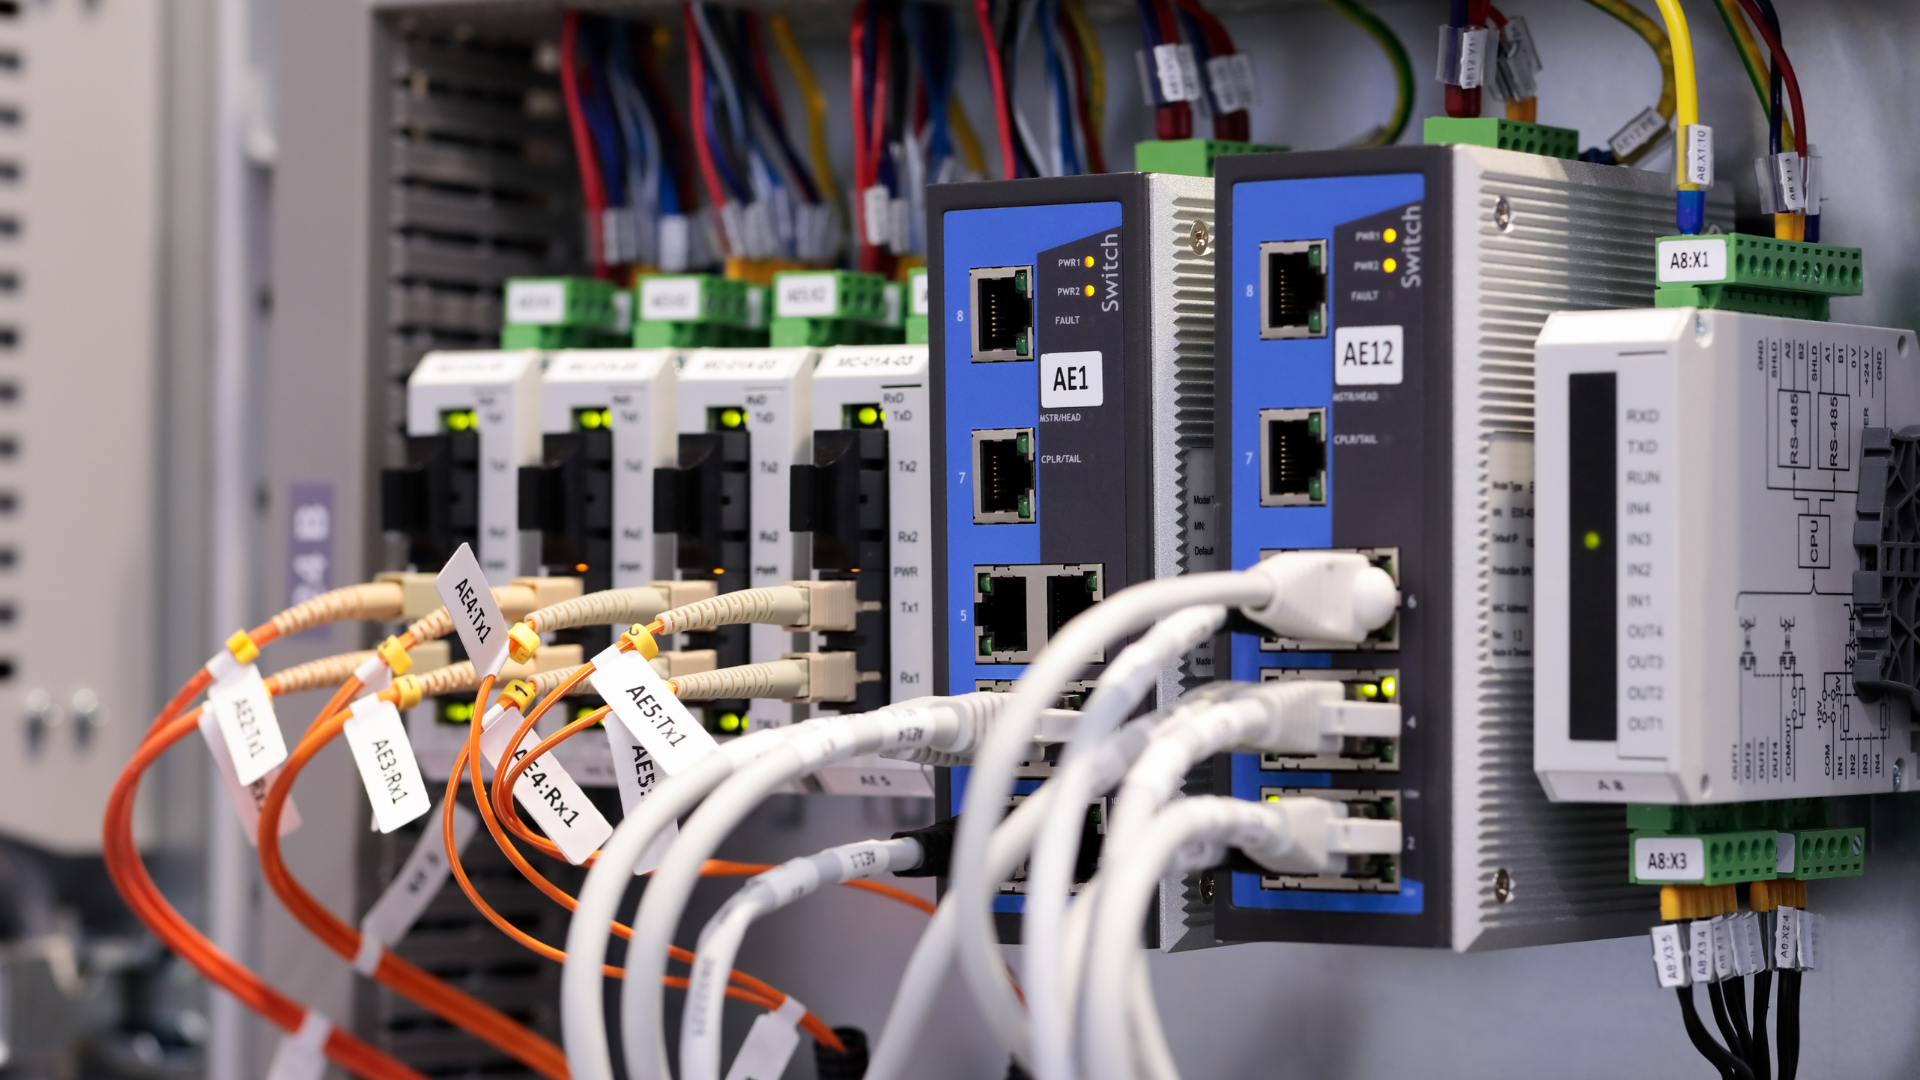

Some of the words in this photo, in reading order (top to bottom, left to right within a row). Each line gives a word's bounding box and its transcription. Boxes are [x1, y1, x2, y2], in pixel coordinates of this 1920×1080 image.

[1355, 231, 1381, 242] PWR1
[1401, 205, 1422, 288] Switch
[1058, 258, 1081, 268] PWR1
[1353, 261, 1380, 272] PWR2
[1670, 250, 1709, 270] A8:X1
[1101, 233, 1119, 312] Switch
[1057, 287, 1081, 296] PWR2
[1246, 285, 1254, 298] 8
[1351, 290, 1380, 301] FAULT
[956, 310, 964, 322] 8
[1055, 316, 1080, 325] FAULT
[1343, 340, 1394, 367] AE12
[1785, 342, 1791, 359] A2
[1798, 343, 1804, 360] B2
[1825, 347, 1831, 363] A1
[1838, 348, 1844, 364] B1
[1053, 366, 1089, 392] AE1
[883, 393, 905, 404] RxD
[892, 410, 912, 421] TxD
[1039, 412, 1082, 423] MSTR/HEAD
[1627, 409, 1660, 424] RXD
[1790, 393, 1799, 465] RS-485
[1830, 396, 1838, 467] RS-485
[1333, 434, 1378, 445] CPLR/TAIL
[1627, 440, 1659, 455] TXD
[1041, 454, 1082, 464] CPLR/TAIL
[1245, 452, 1254, 465] 7
[898, 462, 917, 472] Tx2
[958, 472, 966, 484] 7
[1627, 471, 1661, 485] RUN
[1193, 494, 1211, 505] Model
[1627, 503, 1652, 516] IN4
[1194, 521, 1206, 531] MN:
[898, 531, 918, 542] Rx2
[1627, 533, 1652, 546] IN3
[1810, 519, 1819, 563] CPU
[894, 567, 918, 577] PWR
[1627, 564, 1652, 577] IN2
[901, 602, 919, 613] Tx1
[1407, 594, 1418, 609] 6
[1627, 594, 1652, 608] IN1
[455, 578, 491, 644] AE4:Tx1
[960, 610, 967, 622] 5
[1627, 624, 1664, 639] OUT4
[1196, 657, 1212, 666] Made
[1627, 654, 1664, 670] OUT3
[900, 672, 920, 684] Rx1
[515, 684, 528, 697] 1
[1627, 685, 1664, 701] OUT2
[626, 685, 687, 748] AE5:Tx1
[1406, 716, 1417, 729] 4
[233, 697, 265, 759] AE2:Tx1
[1627, 716, 1664, 732] OUT1
[372, 739, 409, 805] AE3:Rx1
[514, 748, 580, 828] AE4:Rx1
[1406, 835, 1416, 851] 2
[1648, 852, 1688, 870] A8:X3
